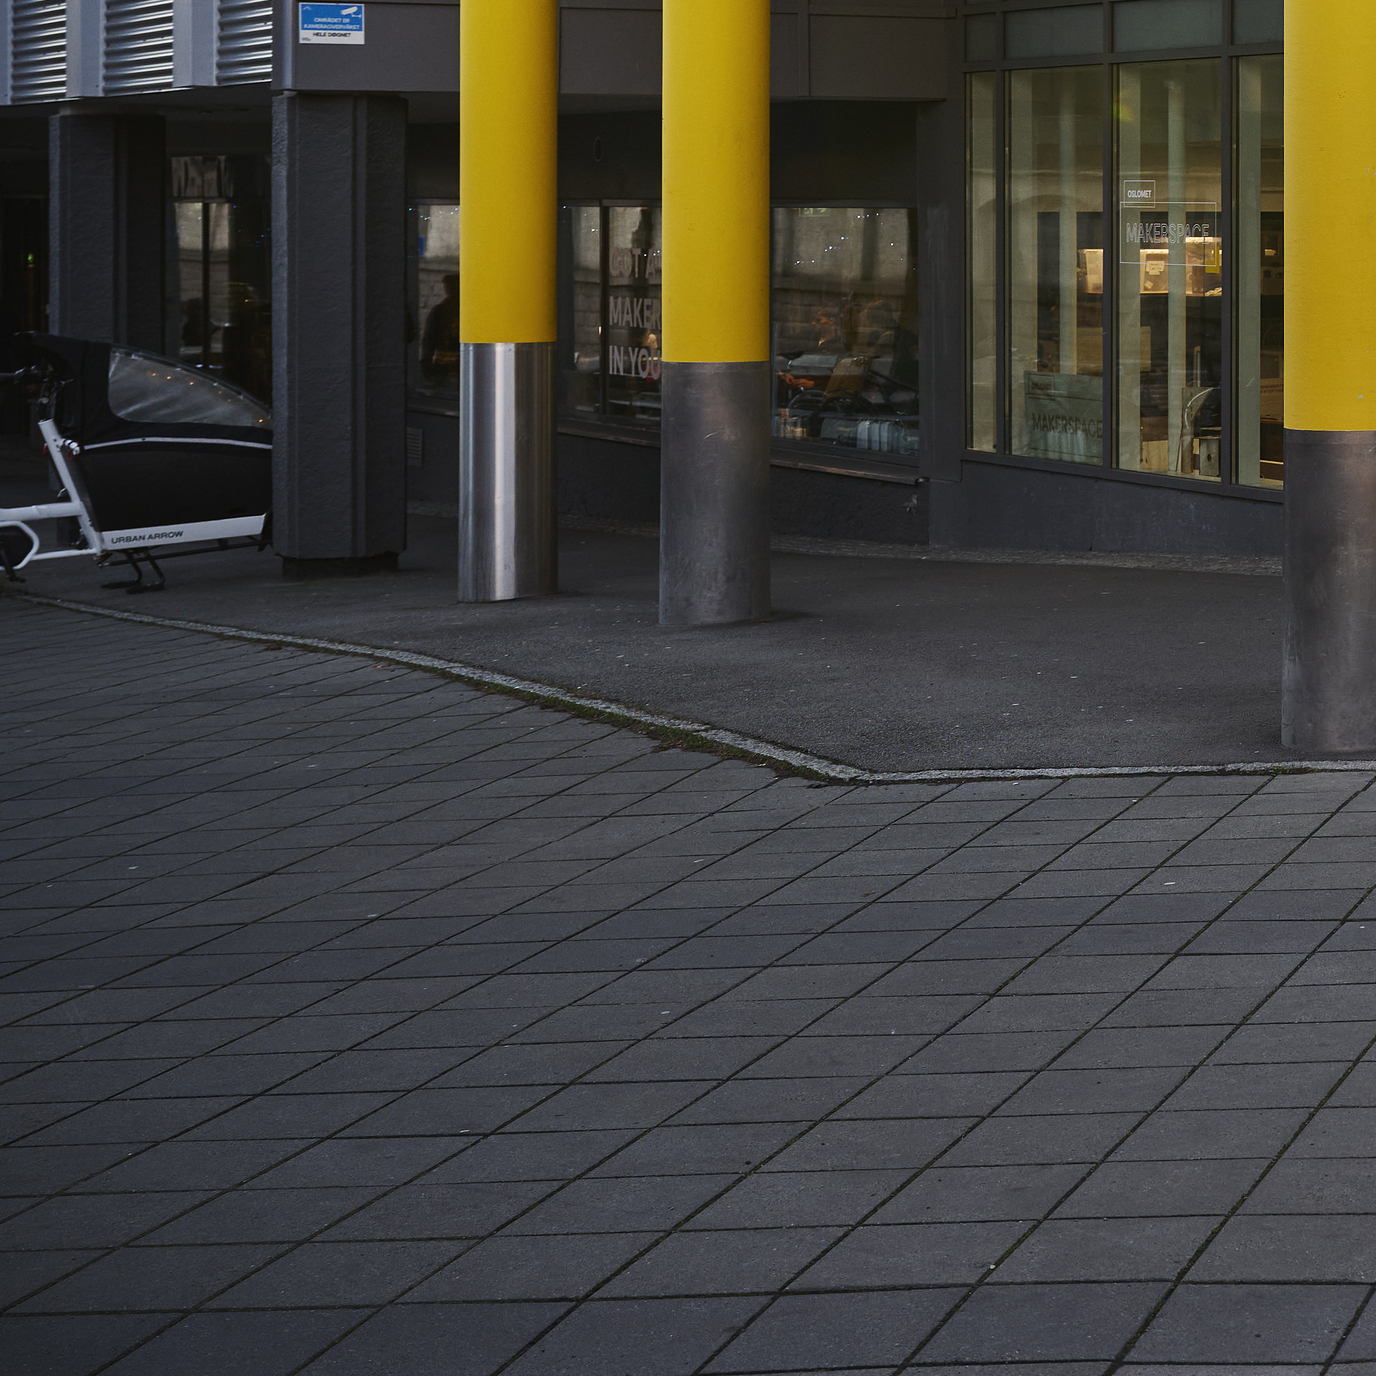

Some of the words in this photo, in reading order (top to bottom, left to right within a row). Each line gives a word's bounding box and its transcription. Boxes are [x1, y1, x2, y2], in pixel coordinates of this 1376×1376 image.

[1127, 189, 1152, 198] OSLOMET
[1125, 222, 1210, 244] MAKERSPACE
[609, 247, 642, 278] GOT
[609, 296, 662, 330] MAKER
[609, 345, 624, 376] IN
[628, 347, 661, 380] YOU
[1032, 412, 1103, 439] MAKERSPACE
[111, 534, 146, 544] URBAN
[147, 530, 184, 541] ARROW
